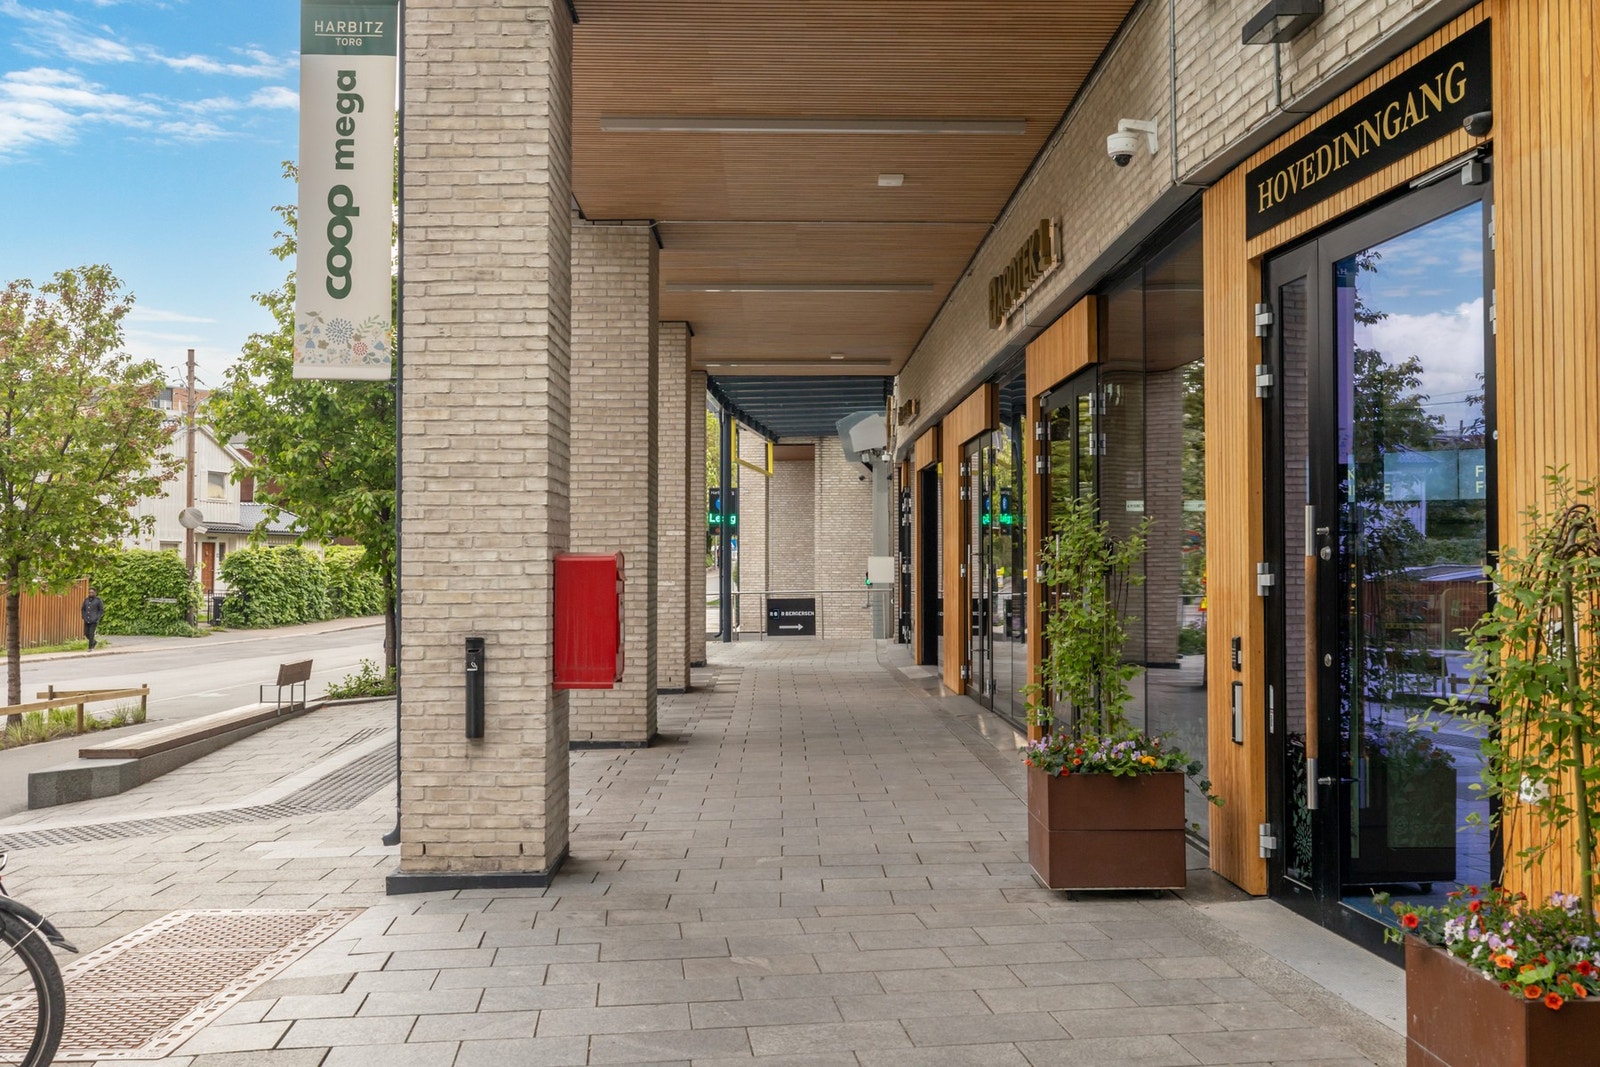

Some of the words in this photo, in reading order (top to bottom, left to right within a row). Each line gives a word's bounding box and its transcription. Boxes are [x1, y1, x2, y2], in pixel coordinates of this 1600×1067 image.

[314, 20, 383, 33] HARBITZ
[335, 37, 362, 46] TORG
[335, 70, 364, 170] mega
[1259, 61, 1467, 213] HOVEDINNGANG
[325, 184, 360, 299] coop
[709, 513, 736, 524] Leg
